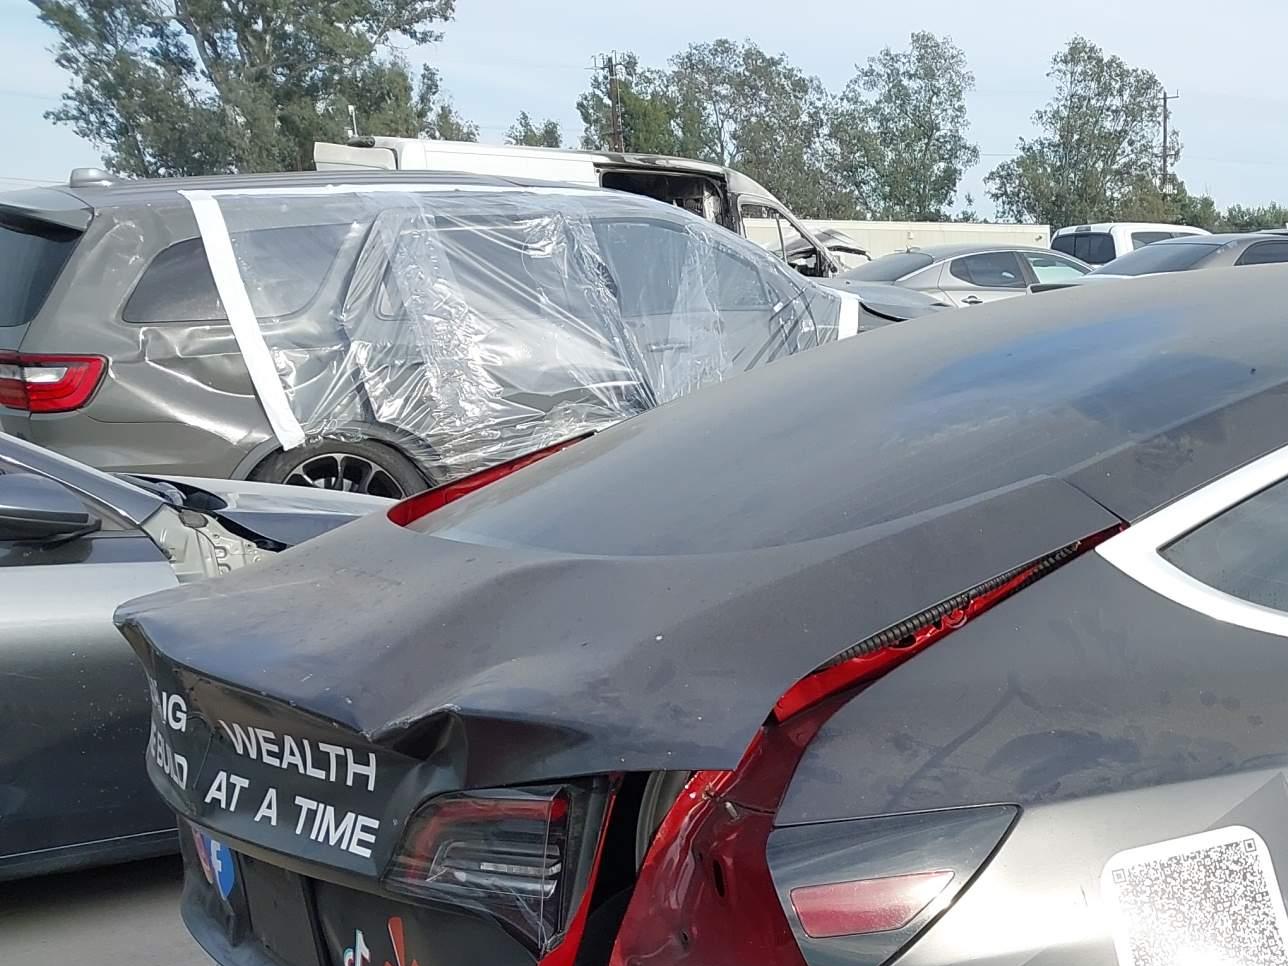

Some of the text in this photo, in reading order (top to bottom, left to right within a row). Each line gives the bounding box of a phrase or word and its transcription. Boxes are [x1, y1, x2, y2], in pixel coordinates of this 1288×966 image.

[218, 719, 376, 792] WEALTH
[204, 770, 250, 812] AT
[253, 788, 278, 826] A
[294, 795, 380, 859] TIME
